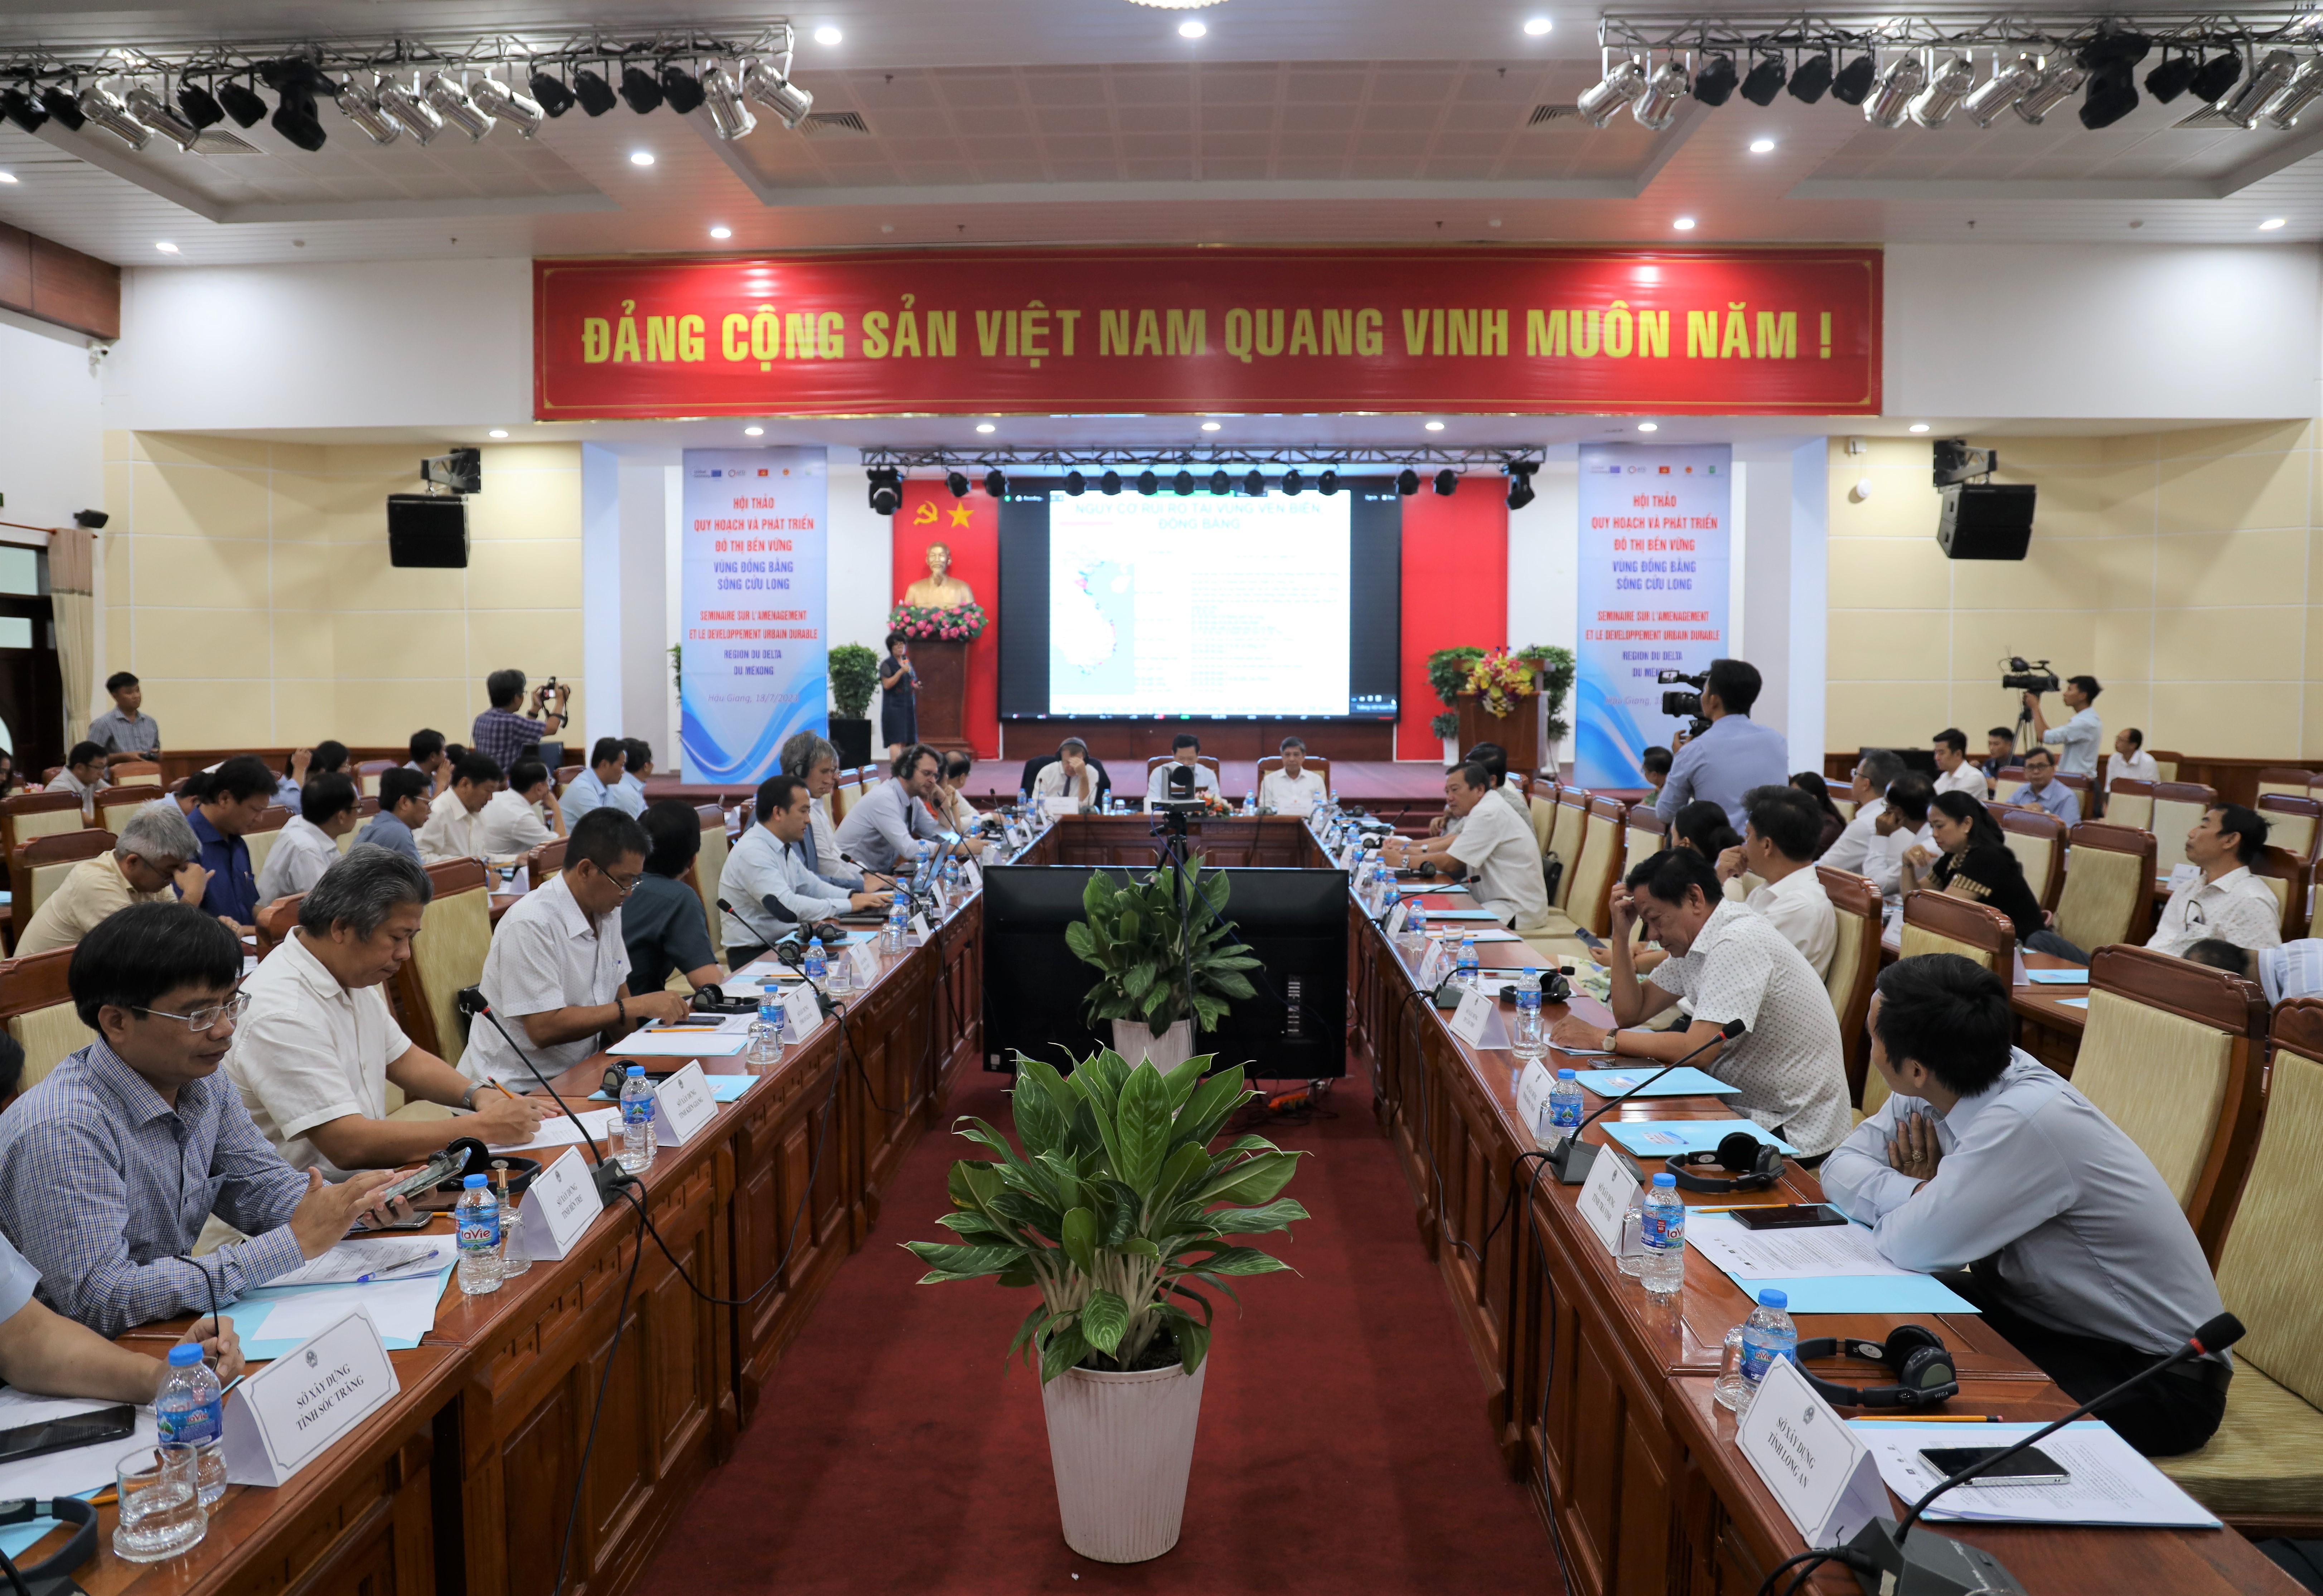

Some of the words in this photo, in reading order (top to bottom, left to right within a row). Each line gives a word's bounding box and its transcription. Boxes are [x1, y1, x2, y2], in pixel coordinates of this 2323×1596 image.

[581, 300, 705, 363] ĐẢNG
[722, 304, 844, 372] CỘNG
[862, 294, 956, 358] SẢN
[975, 300, 1081, 368] VIỆT
[1099, 309, 1206, 355] NAM
[1225, 307, 1383, 363] QUANG
[1401, 309, 1508, 355] VINH
[1526, 300, 1669, 358] MUÔN
[1686, 301, 1797, 359] NĂM
[1820, 311, 1832, 359] !
[734, 495, 748, 511] HỘI
[752, 493, 774, 509] THẢO
[1634, 493, 1649, 509] HỘI
[1653, 491, 1676, 507] THẢO
[1075, 503, 1112, 514] NGUY
[1117, 503, 1138, 514] CƠ
[1259, 503, 1285, 514] VEN
[694, 519, 711, 532] QUY
[714, 519, 744, 533] HOẠCH
[747, 516, 758, 530] VÀ
[762, 516, 784, 530] PHÁT
[788, 513, 814, 529] TRIỂN
[1592, 516, 1610, 529] QUY
[1613, 517, 1645, 531] HOẠCH
[1648, 515, 1660, 528] VÀ
[1663, 515, 1688, 529] PHÁT
[1691, 512, 1718, 529] TRIỂN
[715, 538, 727, 552] ĐÔ
[730, 540, 743, 554] THỊ
[747, 536, 765, 551] BỀN
[768, 537, 792, 551] VỮNG
[1614, 537, 1627, 550] ĐÔ
[1630, 539, 1645, 554] THỊ
[1670, 536, 1695, 550] VỮNG
[713, 558, 737, 573] VÙNG
[740, 557, 765, 572] ĐỒNG
[769, 557, 793, 572] BẰNG
[1613, 558, 1638, 572] VÙNG
[1641, 557, 1668, 572] ĐỒNG
[1671, 556, 1696, 572] BẰNG
[717, 576, 741, 590] SÔNG
[745, 574, 763, 590] CỬU
[766, 578, 789, 590] LONG
[1617, 576, 1642, 590] SÔNG
[1668, 578, 1692, 590] LONG
[700, 610, 735, 620] SEMINAIRE
[737, 610, 749, 620] SUR
[752, 610, 807, 620] L'AMENAGEMENT
[1598, 611, 1634, 621] SEMINAIRE
[1637, 611, 1650, 621] SUR
[1652, 611, 1709, 621] L'AMENAGEMENT
[689, 629, 696, 639] ET
[698, 629, 705, 639] LE
[708, 629, 761, 639] DEVELOPPEMENT
[763, 629, 787, 639] URBAIN
[789, 629, 817, 639] DURABLE
[1586, 630, 1593, 640] ET
[1596, 630, 1603, 640] LE
[1606, 630, 1661, 640] DEVELOPPEMENT
[1664, 630, 1688, 640] URBAIN
[1691, 630, 1720, 640] DURABLE
[724, 650, 749, 659] REGION
[751, 650, 760, 659] DU
[763, 649, 781, 659] DELTA
[1623, 651, 1648, 660] REGION
[1652, 651, 1660, 660] DU
[1663, 651, 1683, 660] DELTA
[734, 666, 742, 675] DU
[1632, 668, 1642, 677] DU
[727, 694, 752, 703] Giang,
[756, 693, 798, 703] 18/7/2023
[1625, 696, 1651, 706] Giang,
[297, 1391, 309, 1409] SỞ
[309, 1381, 325, 1400] XÂY
[326, 1363, 350, 1387] DỰNG
[296, 1408, 319, 1431] TỈNH
[318, 1396, 335, 1415] SÓC
[334, 1375, 364, 1402] TRĂNG
[1776, 1417, 1787, 1432] SỞ
[1785, 1426, 1799, 1447] XÂY
[1797, 1442, 1815, 1469] DỰNG
[1768, 1432, 1784, 1456] TỈNH
[1781, 1450, 1800, 1476] LONG
[1797, 1473, 1809, 1489] AN
